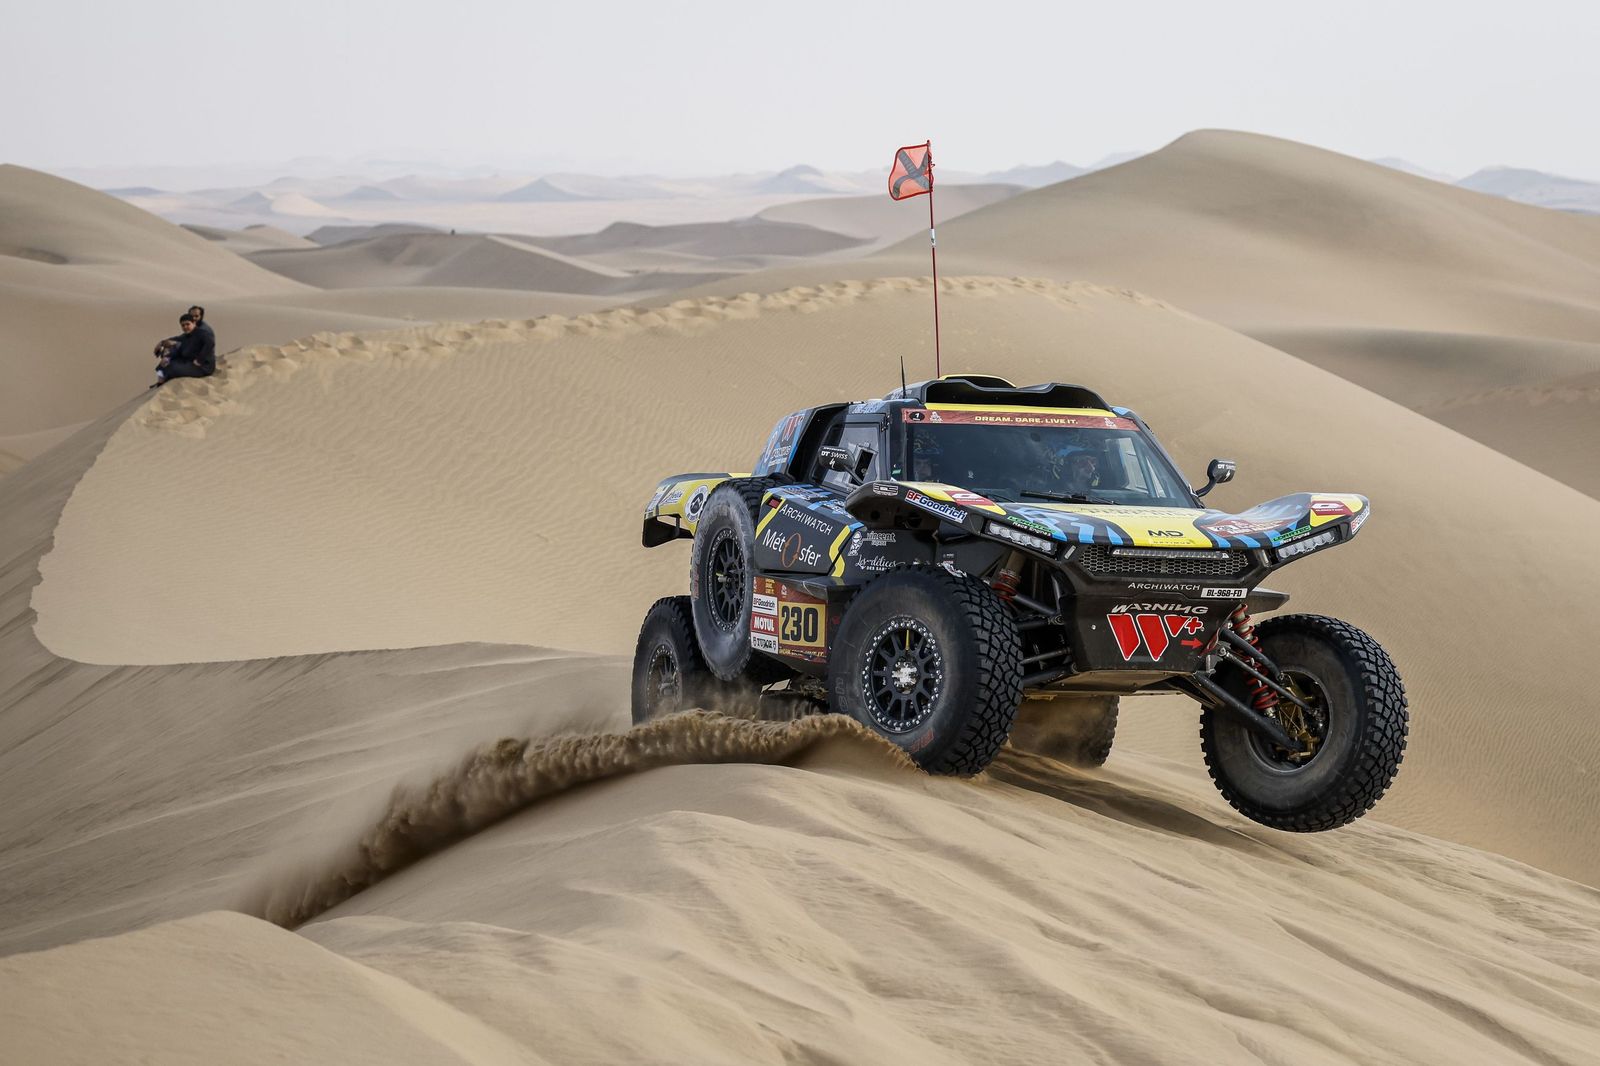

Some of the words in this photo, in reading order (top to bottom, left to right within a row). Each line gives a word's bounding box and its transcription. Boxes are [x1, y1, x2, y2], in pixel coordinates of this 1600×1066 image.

[907, 490, 967, 520] BFGoodrich
[780, 504, 833, 535] ARCHIWATCH
[1128, 582, 1201, 591] ARCHIWATCH
[1206, 589, 1242, 598] BL-968-FD
[753, 616, 775, 632] MOTUL
[781, 605, 819, 643] 230
